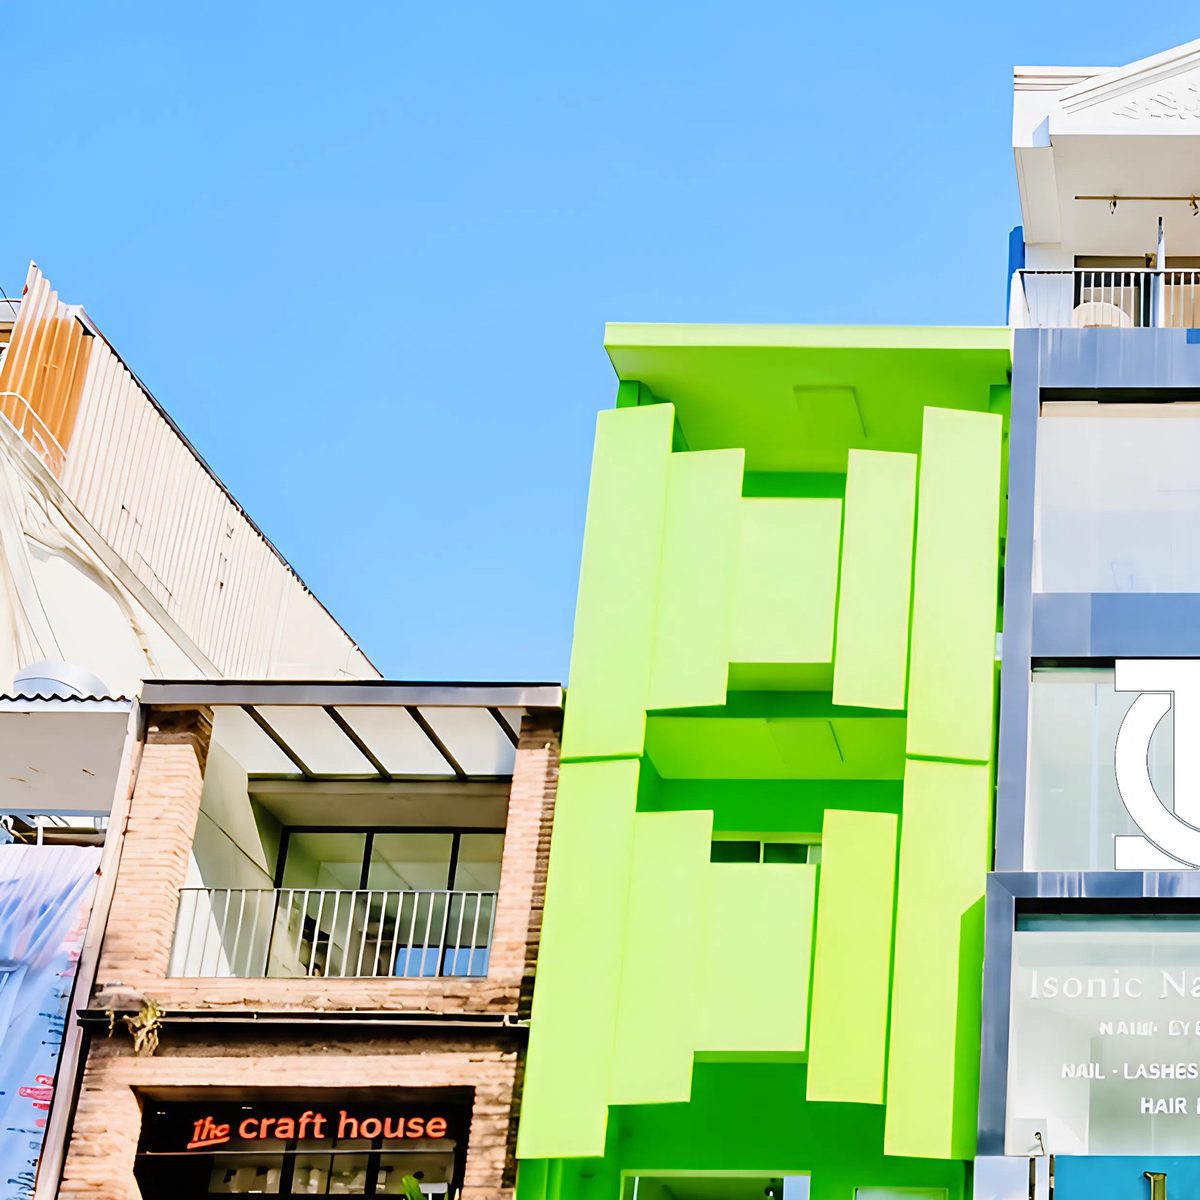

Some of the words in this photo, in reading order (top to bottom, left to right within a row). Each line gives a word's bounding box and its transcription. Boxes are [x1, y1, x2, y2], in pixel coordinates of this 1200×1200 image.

[1030, 969, 1143, 999] Isonic
[1061, 1062, 1105, 1080] NAIL
[1123, 1062, 1199, 1080] LASHES
[1140, 1096, 1188, 1115] HAIR
[238, 1110, 327, 1139] craft
[337, 1110, 448, 1140] house
